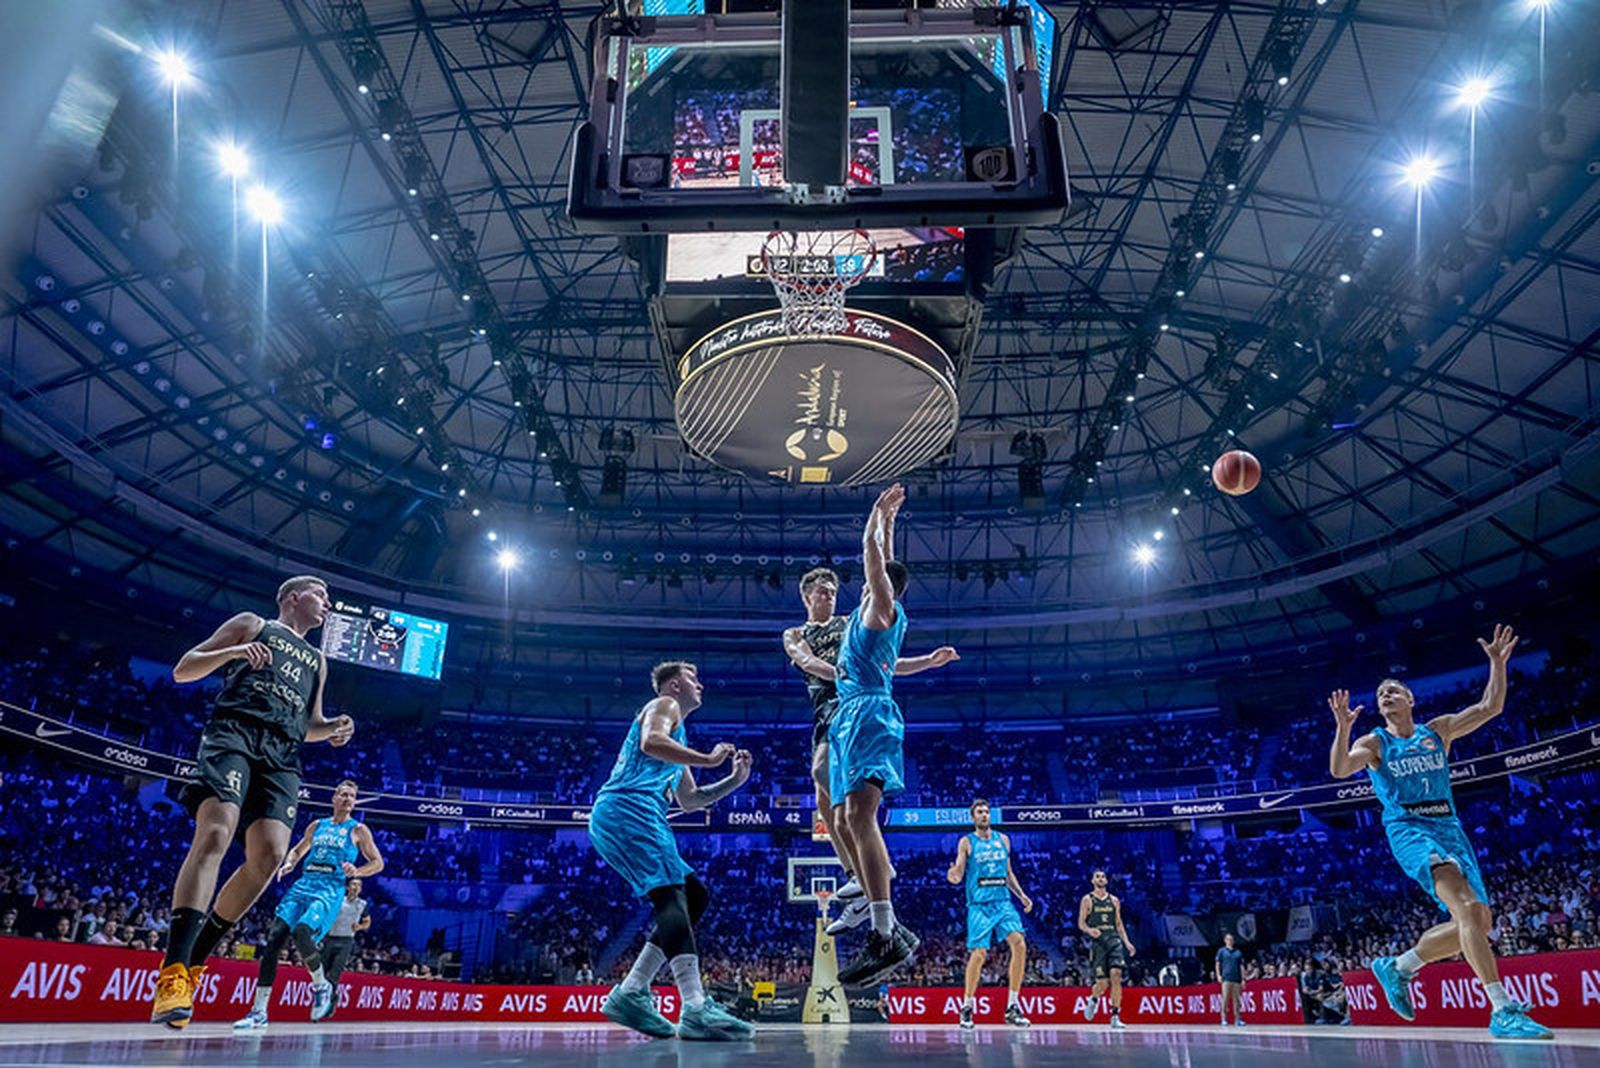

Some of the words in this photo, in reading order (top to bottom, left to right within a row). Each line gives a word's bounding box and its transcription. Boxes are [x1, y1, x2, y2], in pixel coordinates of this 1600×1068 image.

[267, 635, 319, 672] ESPAÑA
[280, 660, 303, 683] 44
[1504, 745, 1559, 768] finetwork
[727, 810, 772, 825] ESPAÑA
[785, 812, 800, 823] 42
[1017, 810, 1061, 820] endesa
[1172, 802, 1225, 816] finetwork
[10, 961, 87, 1000] AVIS
[230, 976, 258, 1004] AV
[356, 986, 385, 1009] AVIS
[388, 988, 413, 1010] AVIS
[416, 990, 437, 1011] AVIS
[499, 994, 548, 1013] AVIS
[1262, 989, 1287, 1012] AVIS
[1441, 976, 1488, 1009] AVIS
[1138, 996, 1185, 1014] AVIS
